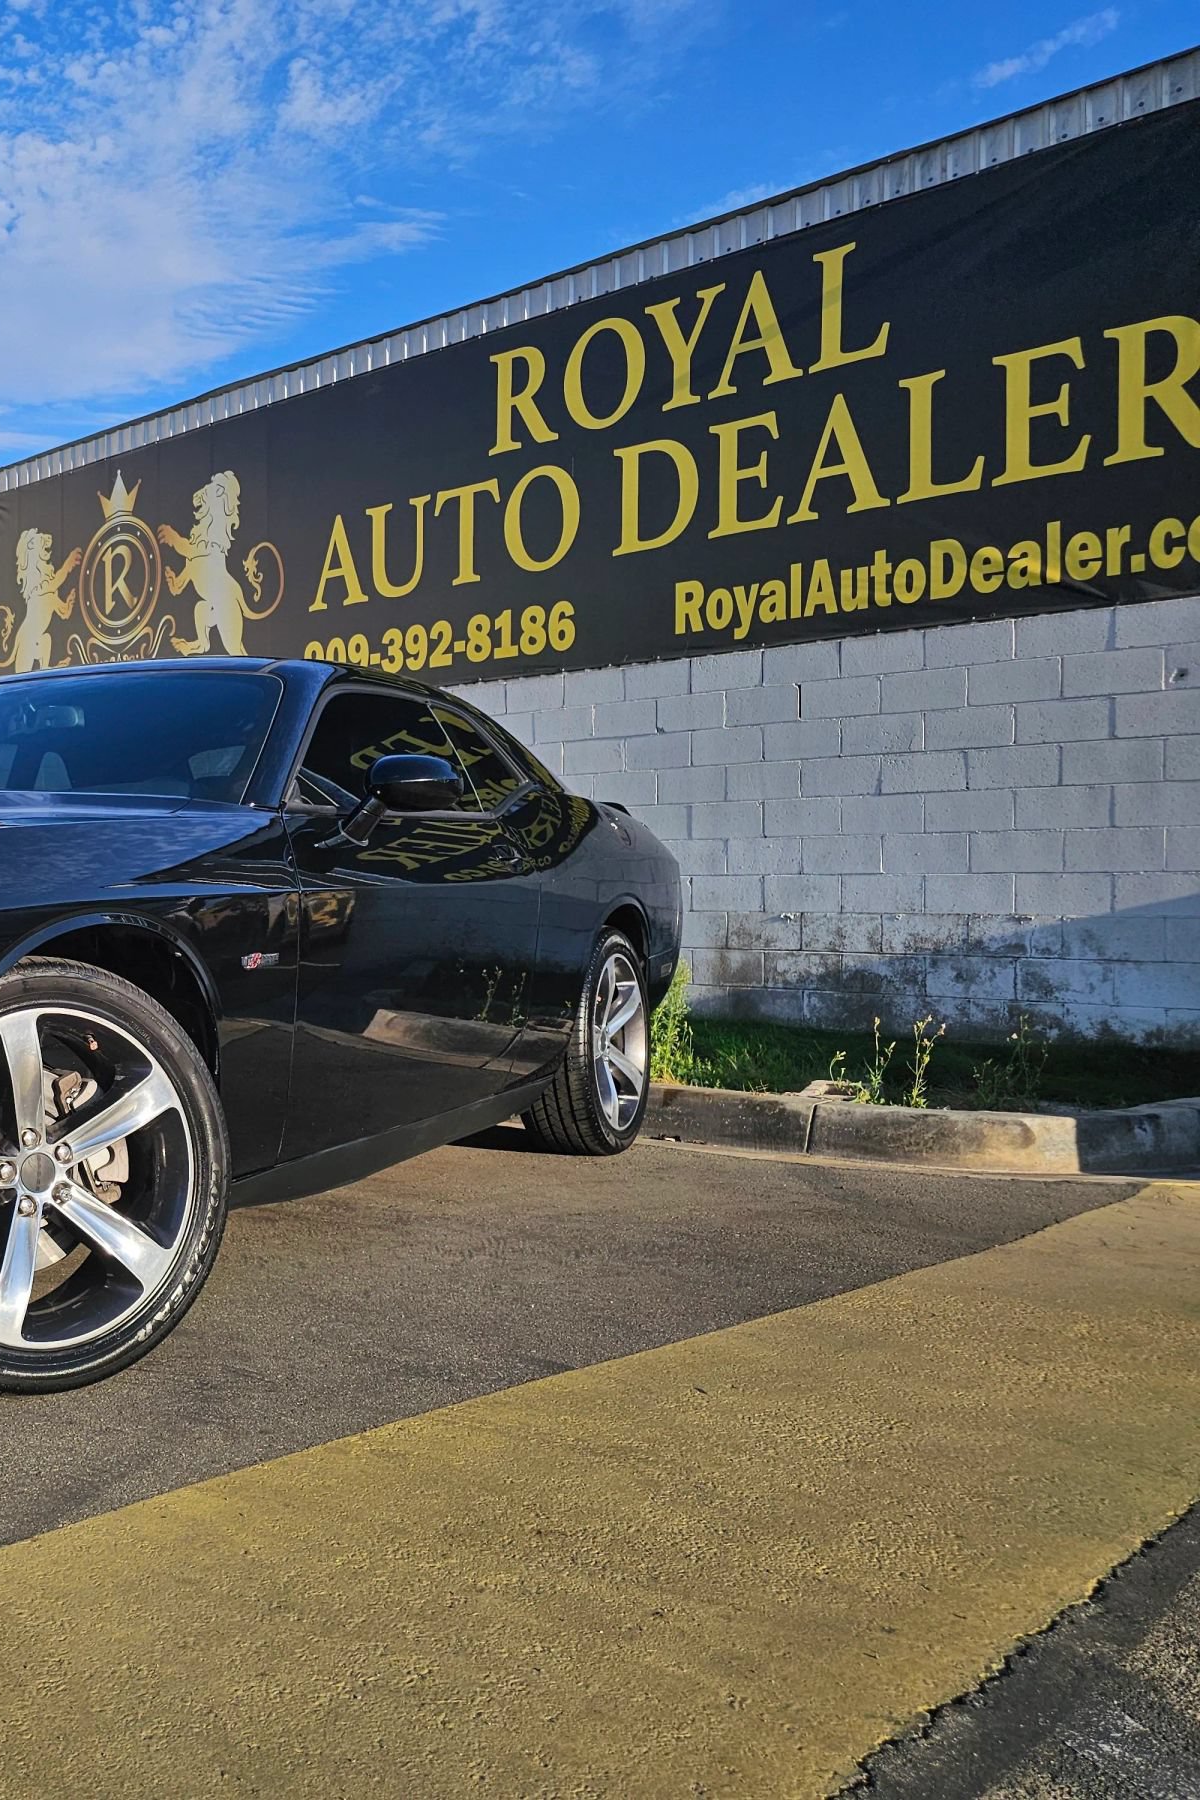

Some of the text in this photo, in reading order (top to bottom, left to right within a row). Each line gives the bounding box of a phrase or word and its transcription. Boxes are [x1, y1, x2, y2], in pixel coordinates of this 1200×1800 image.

[490, 242, 890, 456] ROYAL
[309, 315, 1200, 612] AUTO DEALER
[101, 544, 138, 616] R
